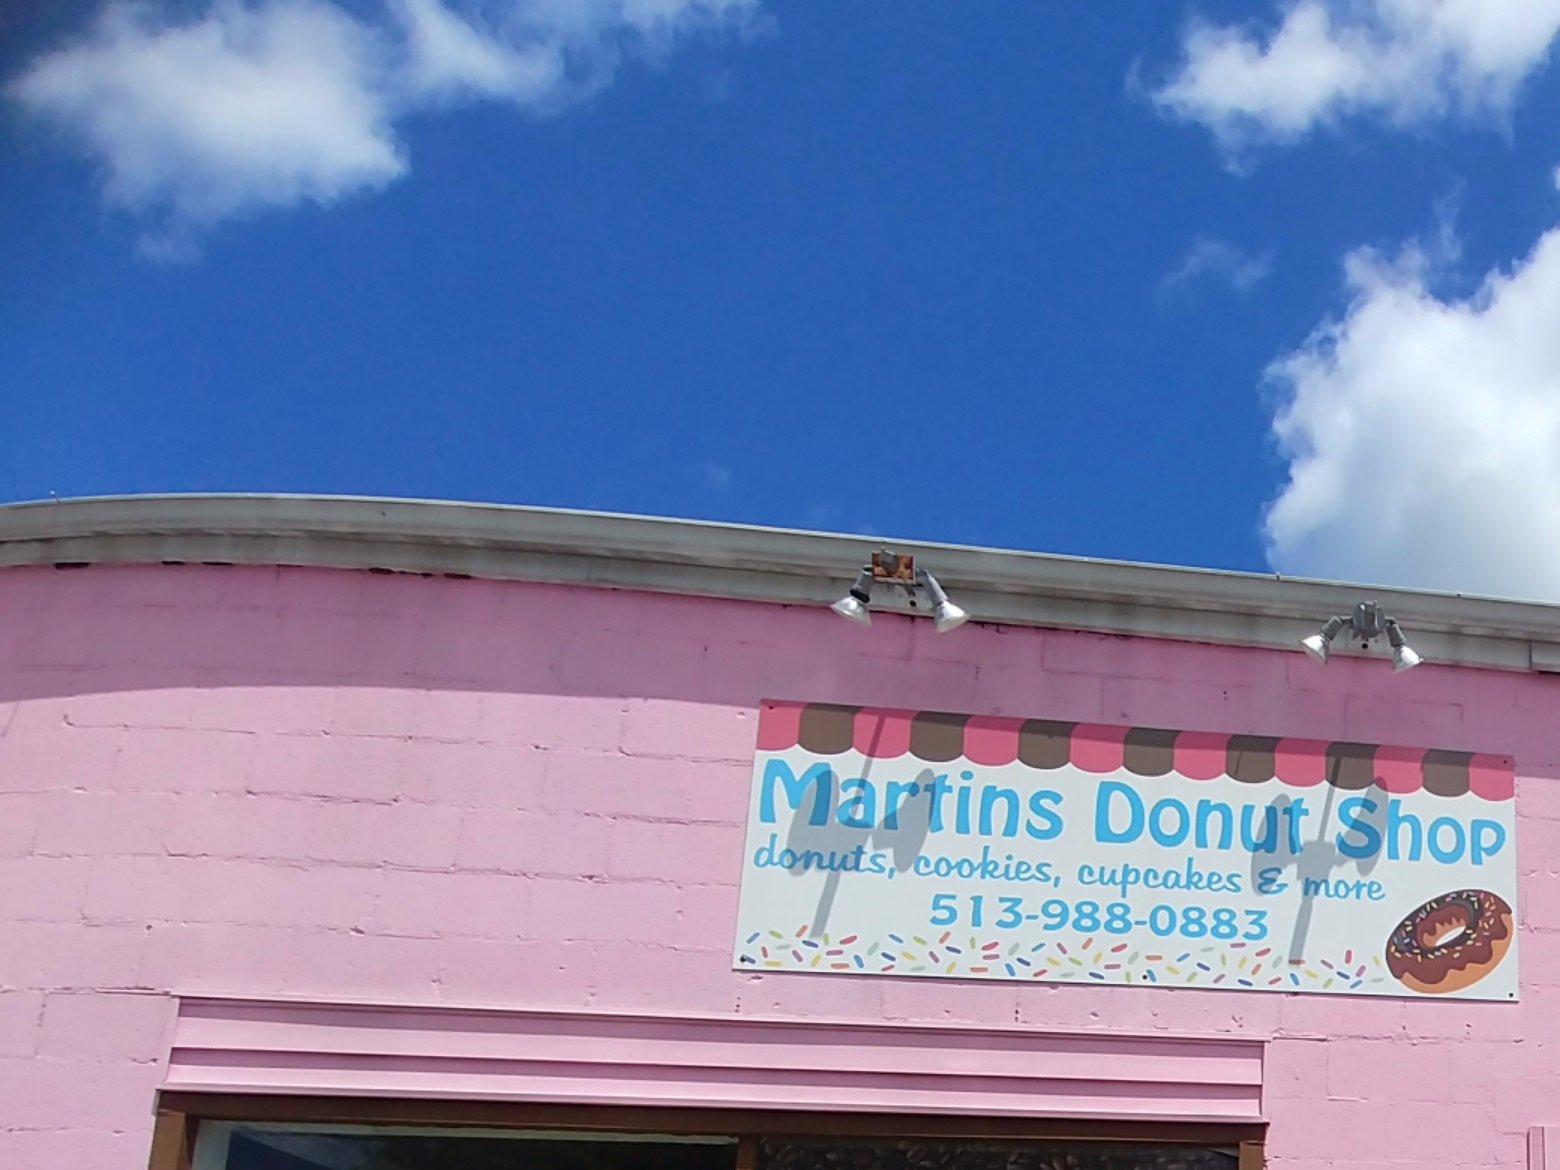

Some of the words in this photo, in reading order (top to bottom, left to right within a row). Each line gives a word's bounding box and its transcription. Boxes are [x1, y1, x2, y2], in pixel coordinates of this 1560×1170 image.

[759, 758, 1064, 840] Martins
[1095, 780, 1309, 855] Donut
[1335, 796, 1506, 866] Shop
[753, 833, 897, 880] donuts,
[913, 845, 1061, 888] cookies,
[1077, 857, 1242, 898] cupcakes
[1257, 866, 1288, 895] &
[1303, 876, 1386, 901] more
[929, 893, 1269, 942] 513-988-0883
